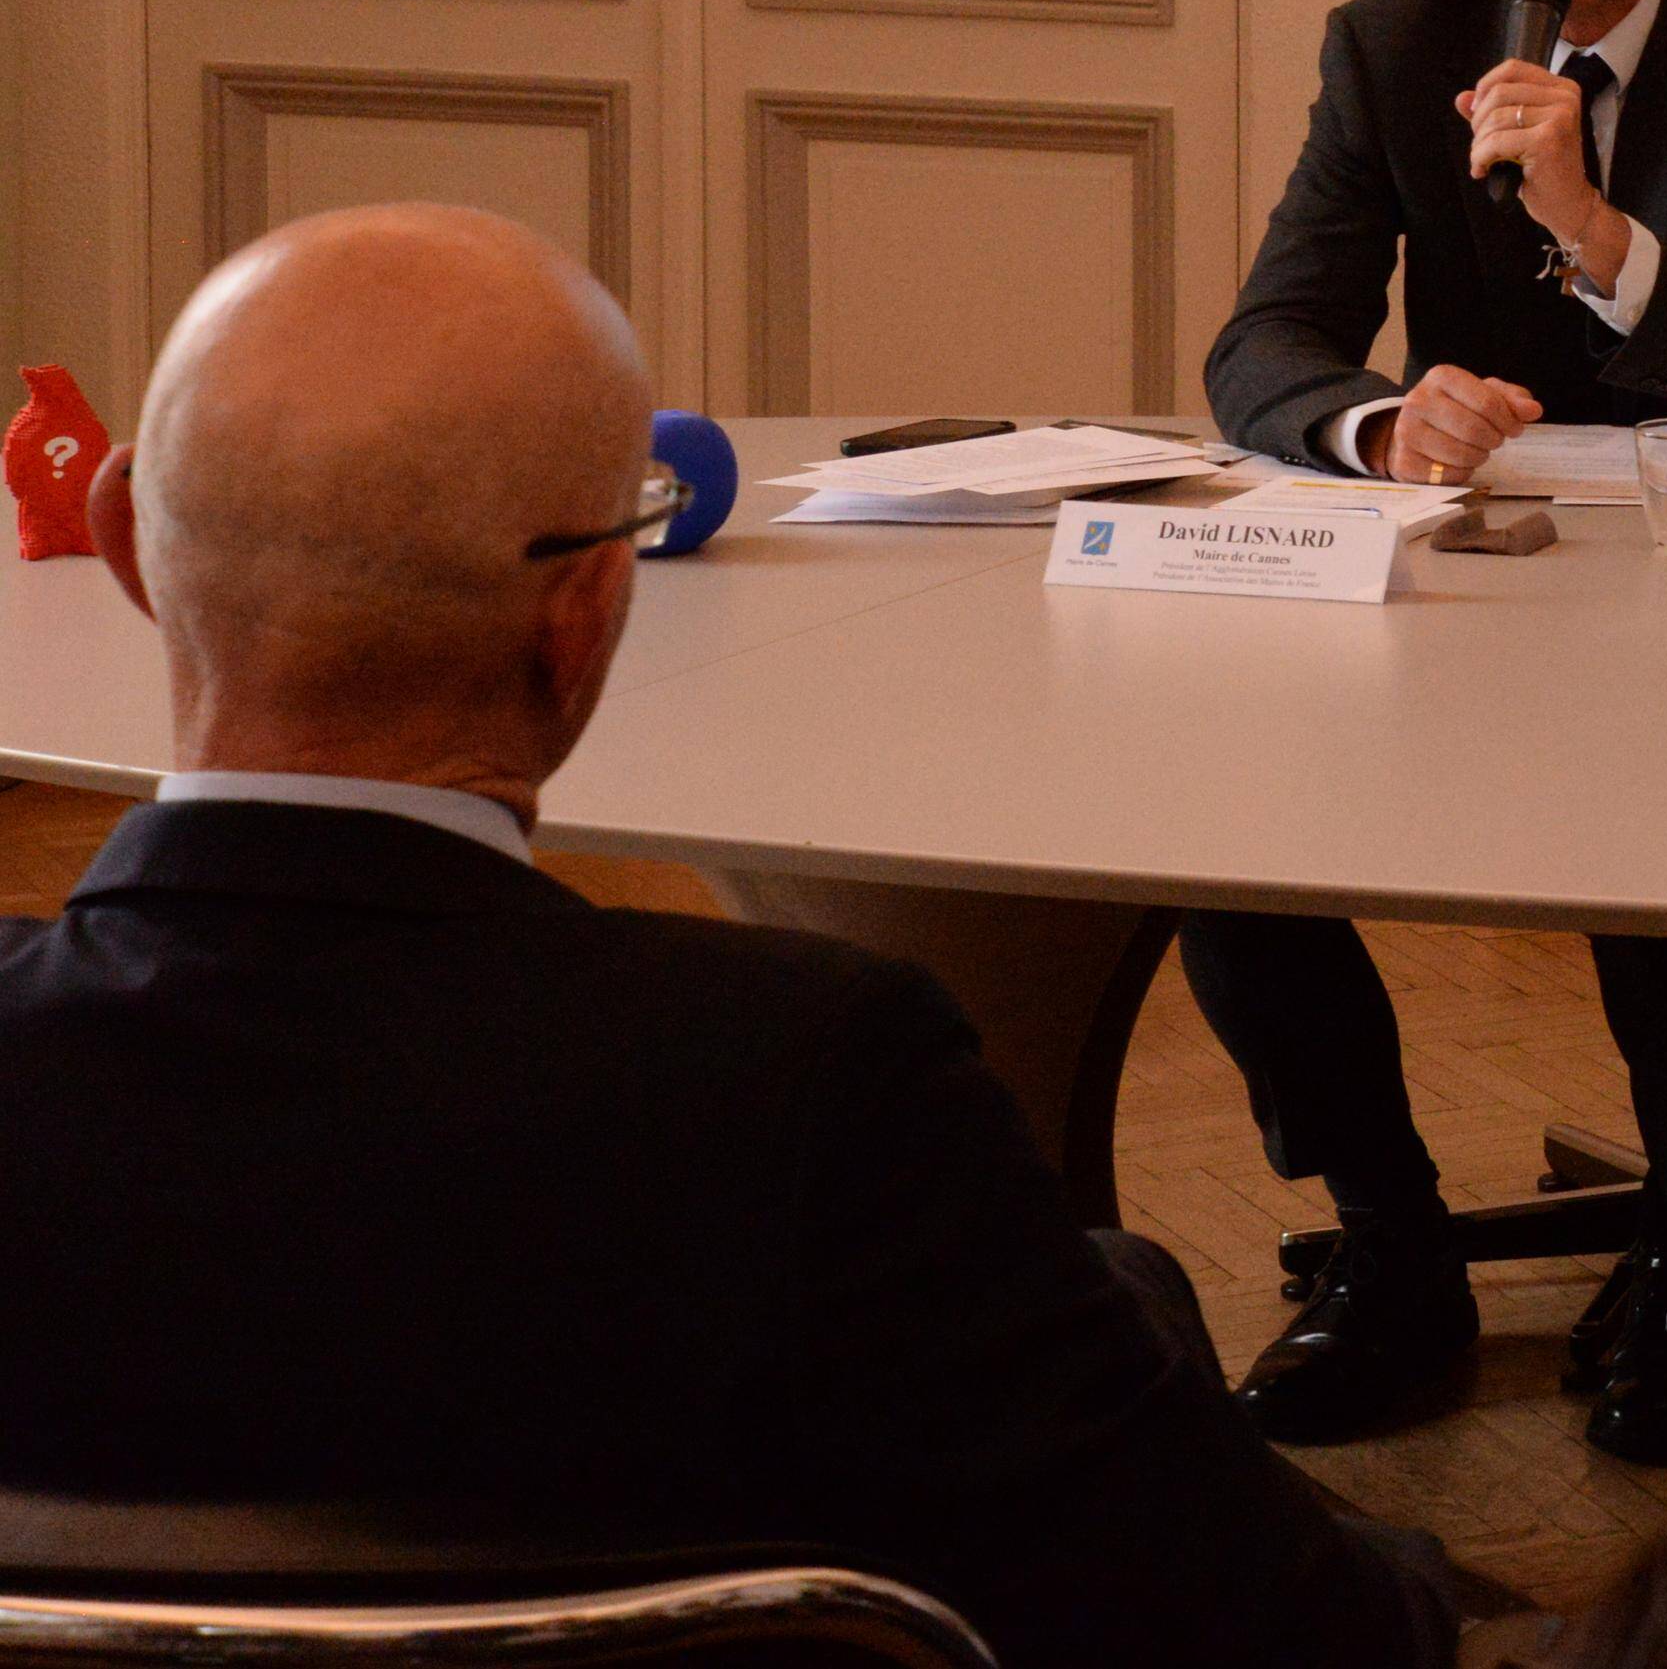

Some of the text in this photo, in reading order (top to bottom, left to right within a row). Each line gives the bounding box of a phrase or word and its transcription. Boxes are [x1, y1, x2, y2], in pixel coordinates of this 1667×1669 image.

[43, 435, 79, 479] ?
[1158, 520, 1335, 549] David LISNARD
[1192, 548, 1291, 565] Maire de Cannes
